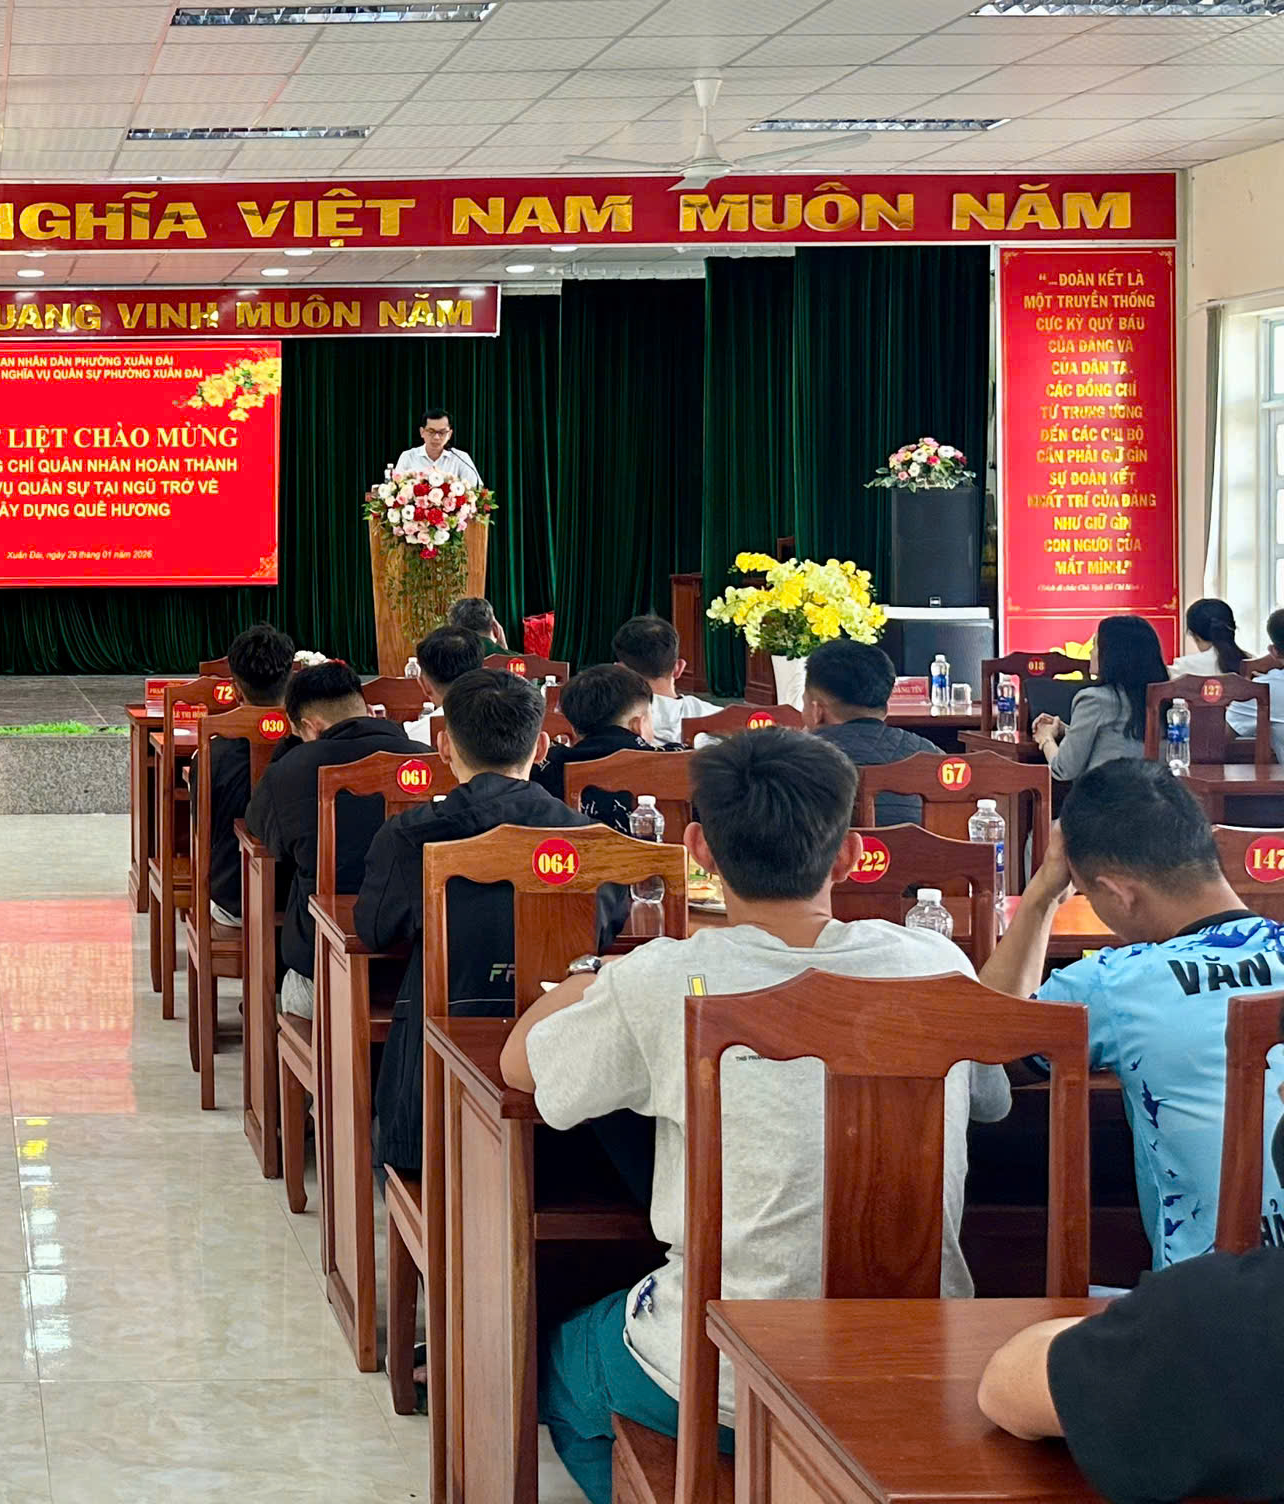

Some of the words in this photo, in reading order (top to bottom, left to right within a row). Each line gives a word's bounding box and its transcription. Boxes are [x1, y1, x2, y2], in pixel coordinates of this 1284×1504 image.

[238, 188, 417, 247] VIỆT
[452, 194, 634, 235] NAM
[679, 181, 916, 232] MUÔN
[951, 184, 1132, 232] NĂM
[1098, 267, 1124, 286] KẾT
[1128, 269, 1145, 286] LÀ
[1023, 292, 1052, 312] MỘT
[1057, 290, 1108, 308] TRUYỀN
[1112, 289, 1156, 309] THỐNG
[117, 302, 221, 330] VINH
[235, 294, 362, 328] MUÔN
[379, 292, 473, 328] NĂM
[1066, 314, 1085, 331] KỲ
[1088, 314, 1115, 332] QUÝ
[18, 356, 48, 367] NHÂN
[50, 356, 73, 367] DÂN
[75, 355, 121, 367] PHƯỜNG
[124, 356, 153, 367] XUÂN
[1081, 358, 1109, 375] DÂN
[1, 368, 34, 380] NGHĨA
[35, 370, 51, 382] VỤ
[53, 368, 83, 380] QUÂN
[104, 367, 151, 380] PHƯỜNG
[153, 367, 182, 379] XUÂN
[1046, 380, 1073, 397] CÁC
[8, 424, 67, 453] LIỆT
[74, 422, 149, 448] CHÀO
[156, 422, 238, 448] MỪNG
[1071, 425, 1098, 442] CÁC
[7, 456, 35, 473] CHÍ
[38, 457, 84, 475] QUÂN
[88, 457, 132, 473] NHÂN
[135, 456, 180, 473] HOÀN
[184, 456, 237, 473] THÀNH
[1070, 469, 1107, 485] ĐOÀN
[17, 478, 63, 497] QUÂN
[67, 479, 90, 498] SỰ
[94, 480, 118, 498] TẠI
[122, 478, 158, 496] NGŨ
[161, 477, 196, 495] TRỞ
[23, 502, 70, 520] DỰNG
[74, 501, 108, 519] QUÊ
[111, 502, 171, 518] HƯƠNG
[102, 550, 112, 559] 01
[216, 686, 234, 700] 72
[1203, 685, 1221, 696] 127
[262, 719, 284, 732] 030
[401, 769, 427, 785] 061
[942, 763, 966, 785] 67
[538, 853, 575, 874] 064
[1252, 848, 1284, 870] 147
[1168, 952, 1273, 996] VĂN
